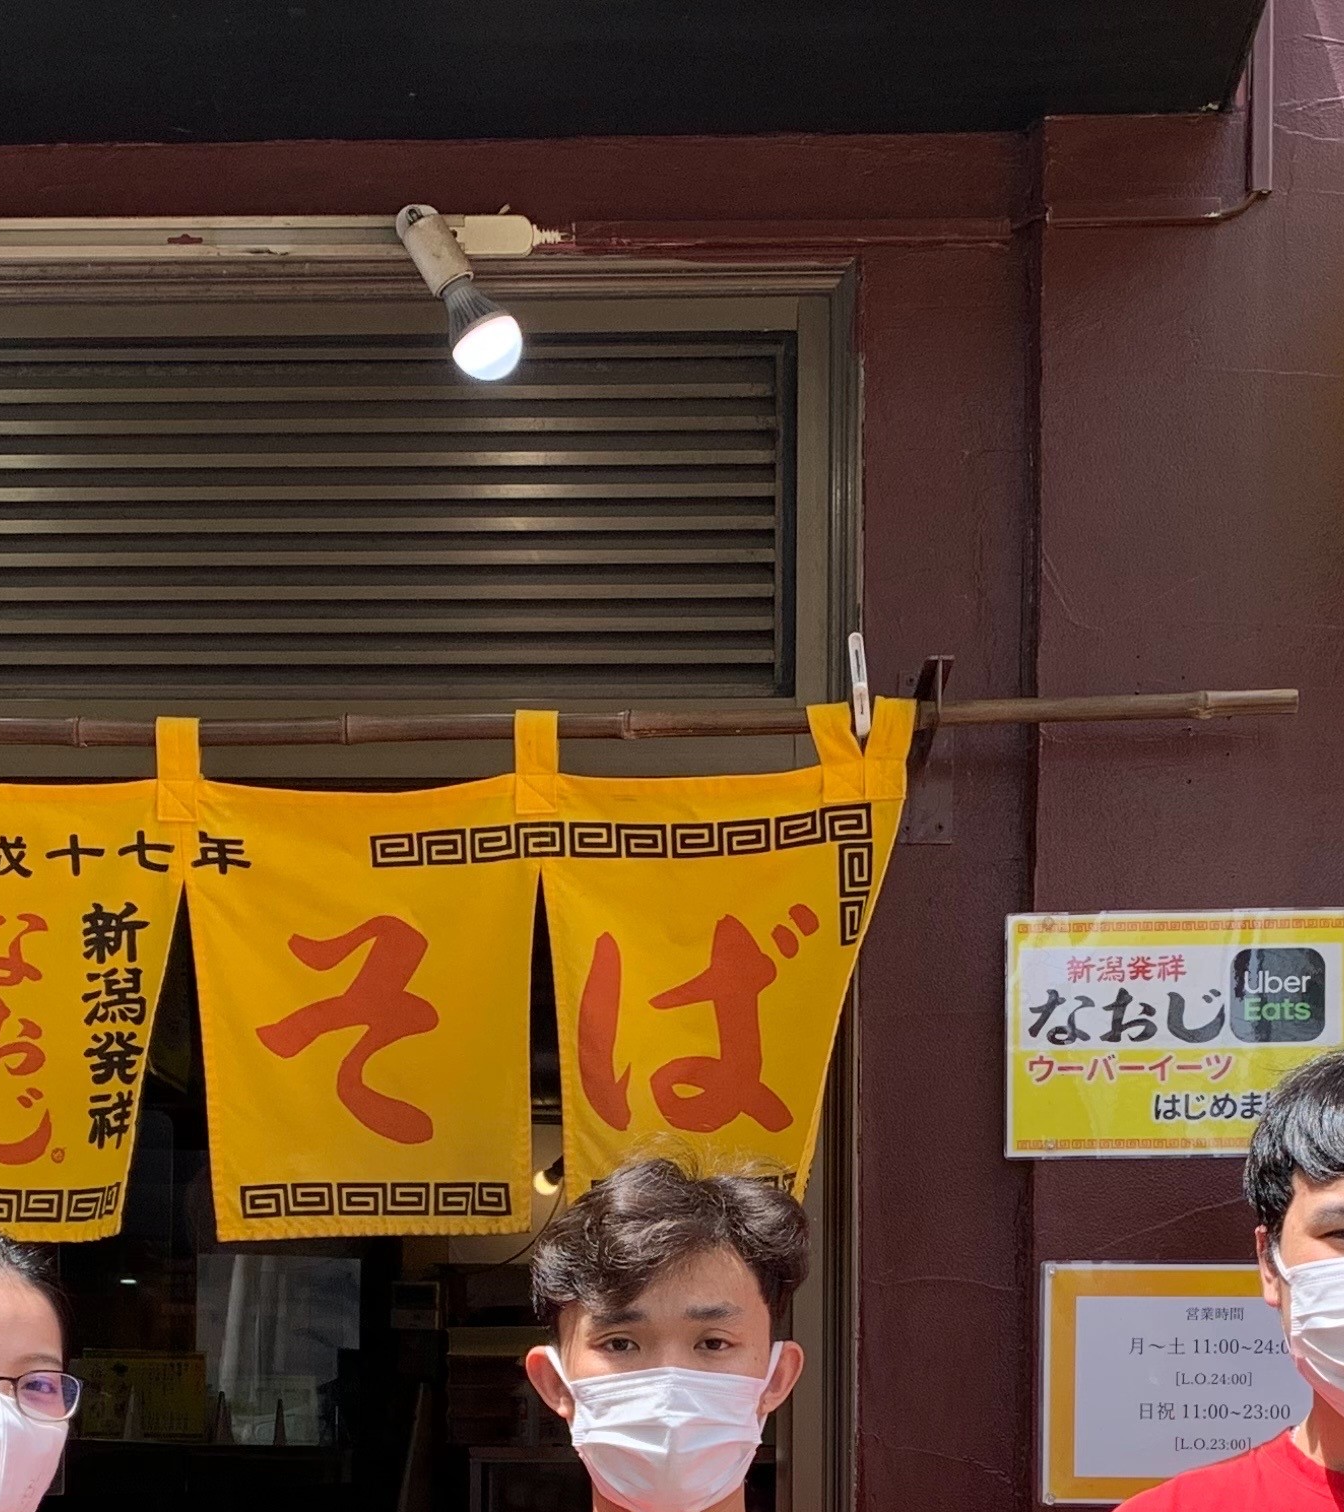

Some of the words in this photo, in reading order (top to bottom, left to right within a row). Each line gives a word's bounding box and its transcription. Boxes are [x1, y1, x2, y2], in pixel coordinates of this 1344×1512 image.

[1067, 954, 1187, 983] 新潟発祥
[1243, 970, 1311, 993] Uber
[1027, 988, 1227, 1045] なおじ
[1243, 998, 1312, 1022] Eats
[81, 902, 151, 1150] 新潟発祥
[1028, 1055, 1233, 1082] ウーバーイーツ
[1154, 1092, 1270, 1120] はじめま
[1185, 1307, 1244, 1321] 営業時間
[1139, 1403, 1176, 1420] 日祝
[1182, 1404, 1291, 1420] 11:00~23:00
